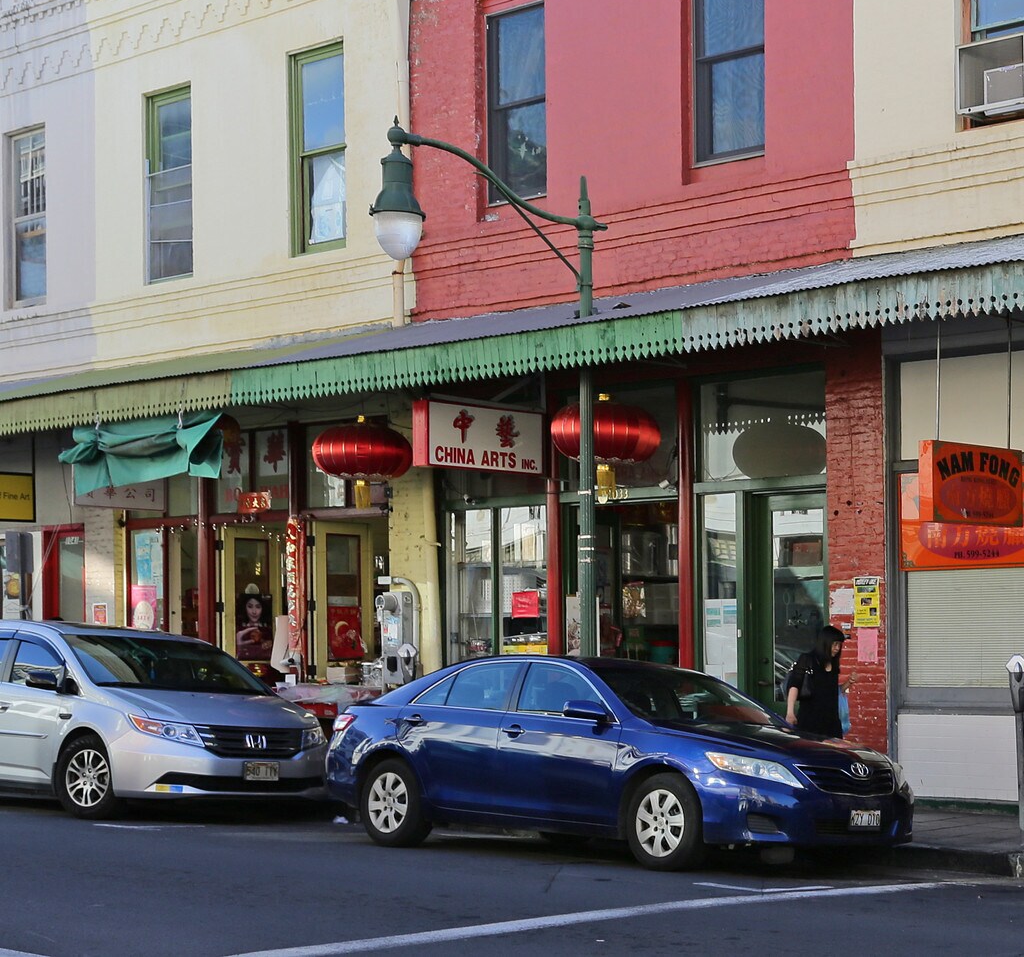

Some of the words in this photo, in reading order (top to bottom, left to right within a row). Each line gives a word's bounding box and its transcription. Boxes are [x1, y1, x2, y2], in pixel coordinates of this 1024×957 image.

[435, 445, 475, 466] CHINA
[481, 450, 517, 469] ARTS
[521, 458, 538, 471] INC.
[936, 450, 975, 482] NAM
[979, 452, 1021, 489] FONG
[3, 491, 18, 500] Fine
[966, 549, 999, 558] 599-5244
